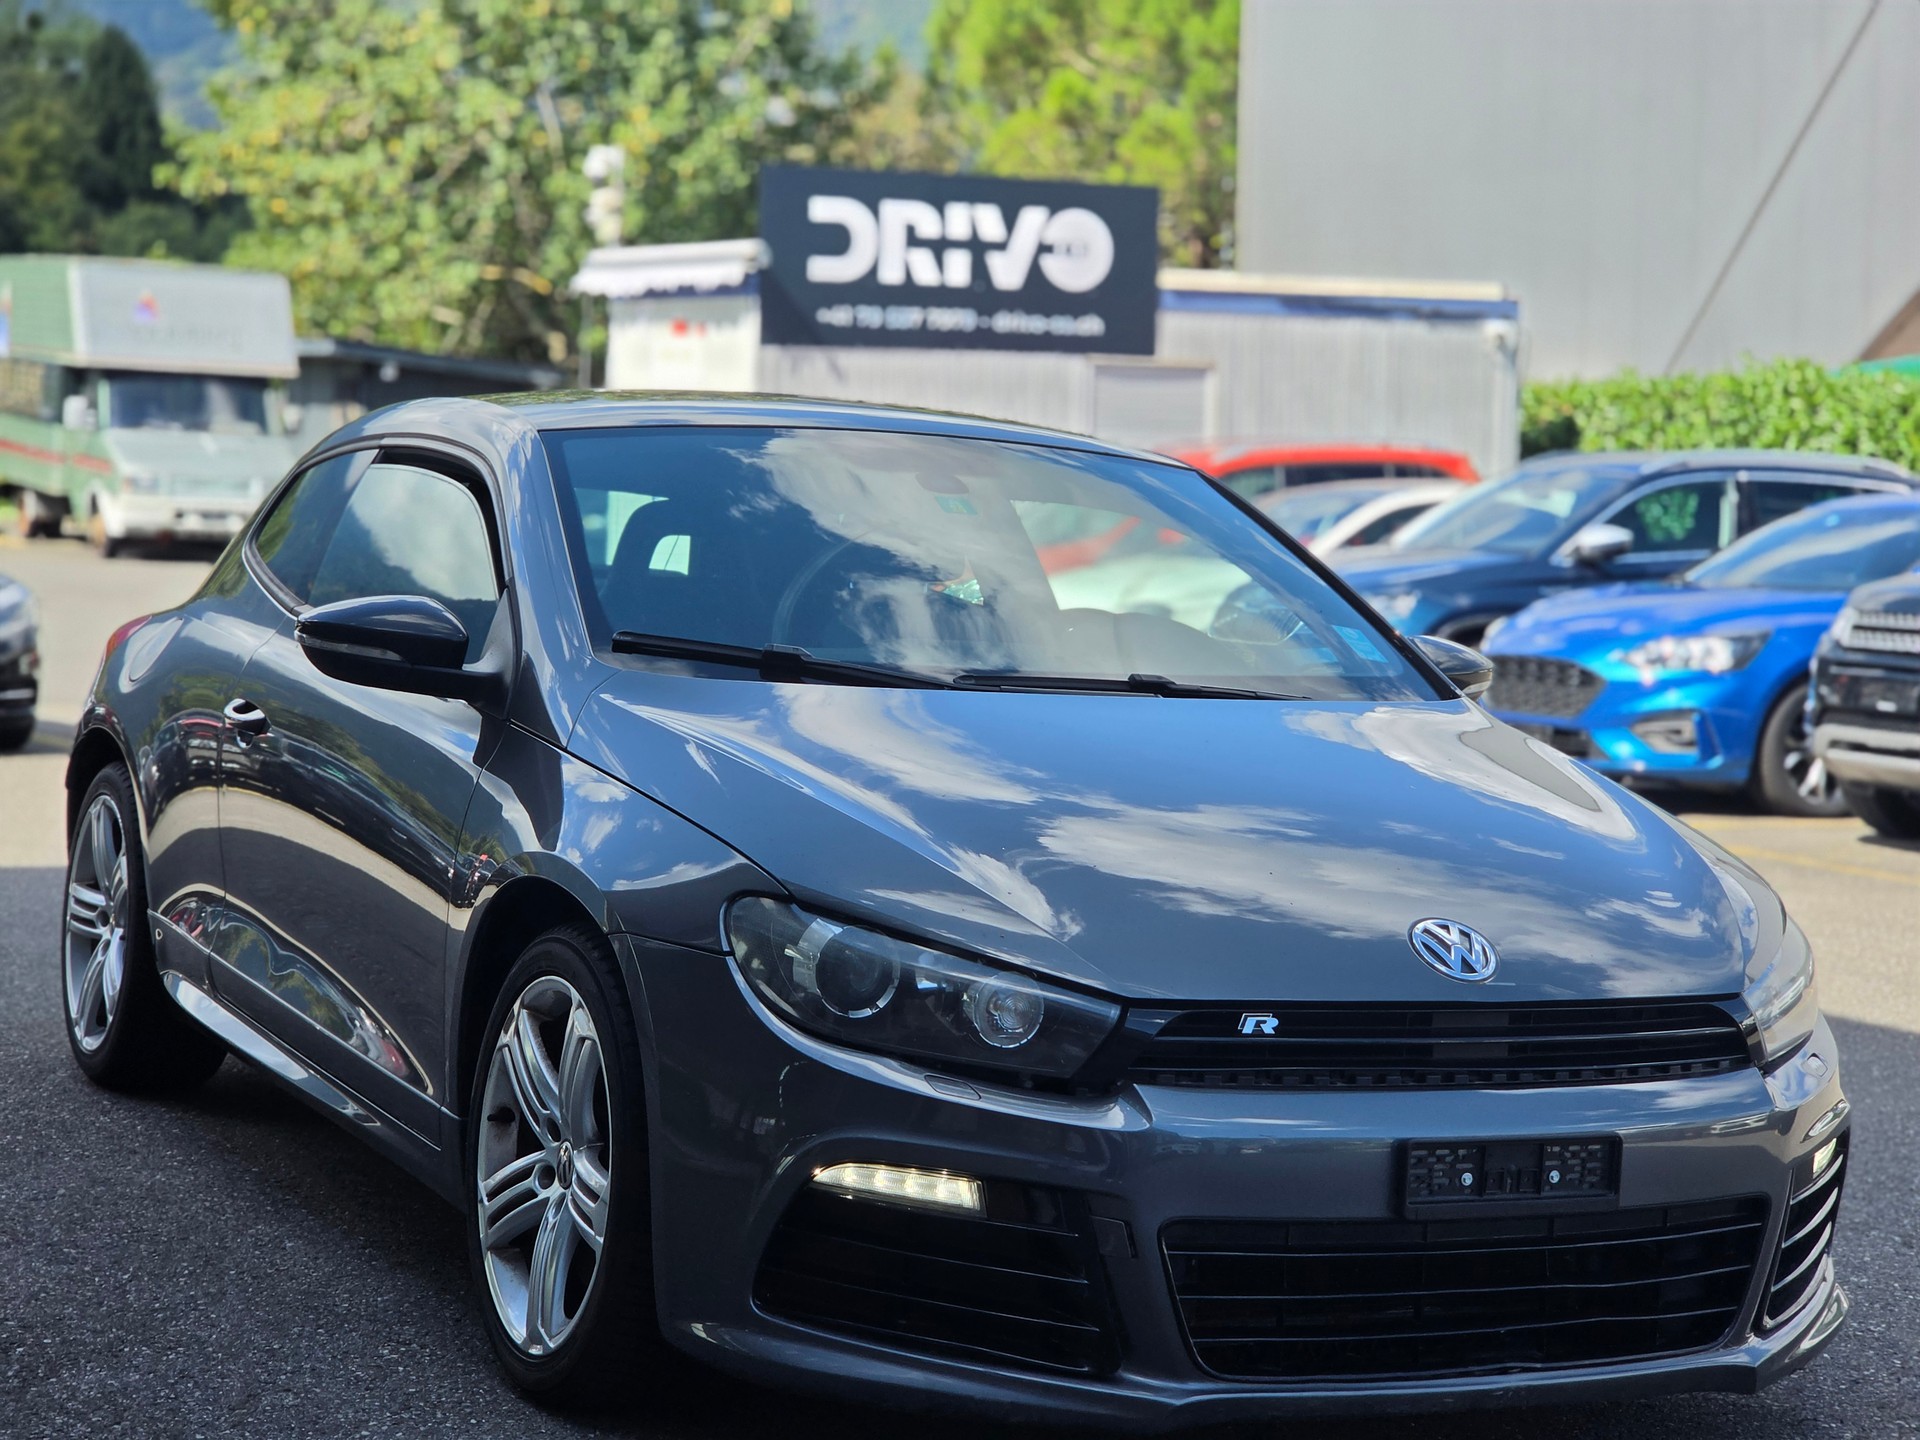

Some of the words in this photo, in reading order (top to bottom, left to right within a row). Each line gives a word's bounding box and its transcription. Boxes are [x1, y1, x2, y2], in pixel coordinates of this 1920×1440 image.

[806, 194, 1114, 293] DRIVO
[1410, 918, 1498, 982] VW
[1238, 1012, 1279, 1035] R
